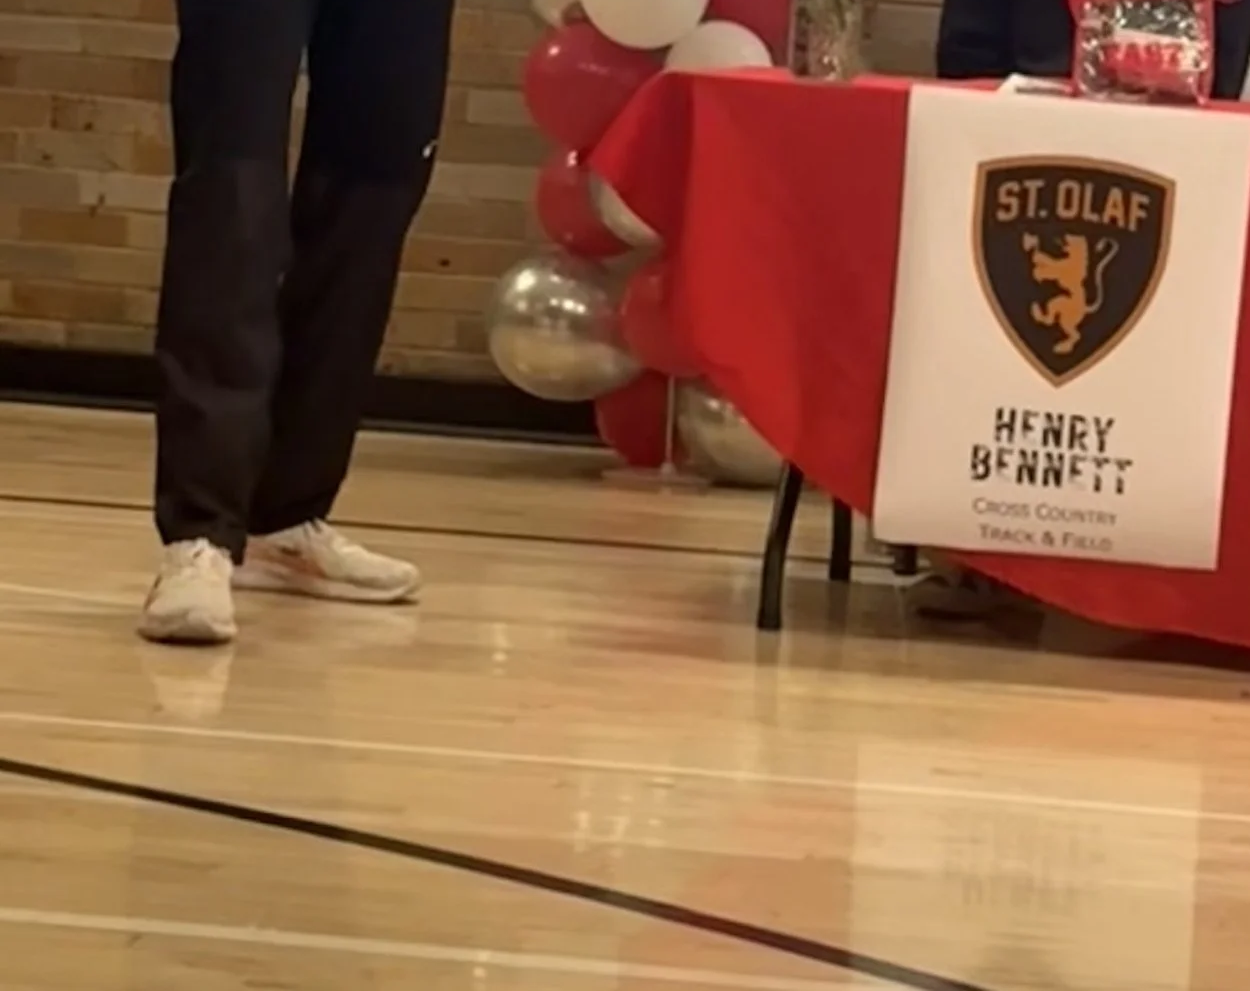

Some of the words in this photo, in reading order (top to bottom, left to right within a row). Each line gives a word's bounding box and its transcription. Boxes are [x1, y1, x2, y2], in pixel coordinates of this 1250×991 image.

[996, 178, 1048, 222] ST.
[1055, 178, 1151, 232] OLAF
[995, 407, 1116, 453] HENRY
[970, 443, 1134, 495] BENNETT
[1041, 530, 1055, 547] &
